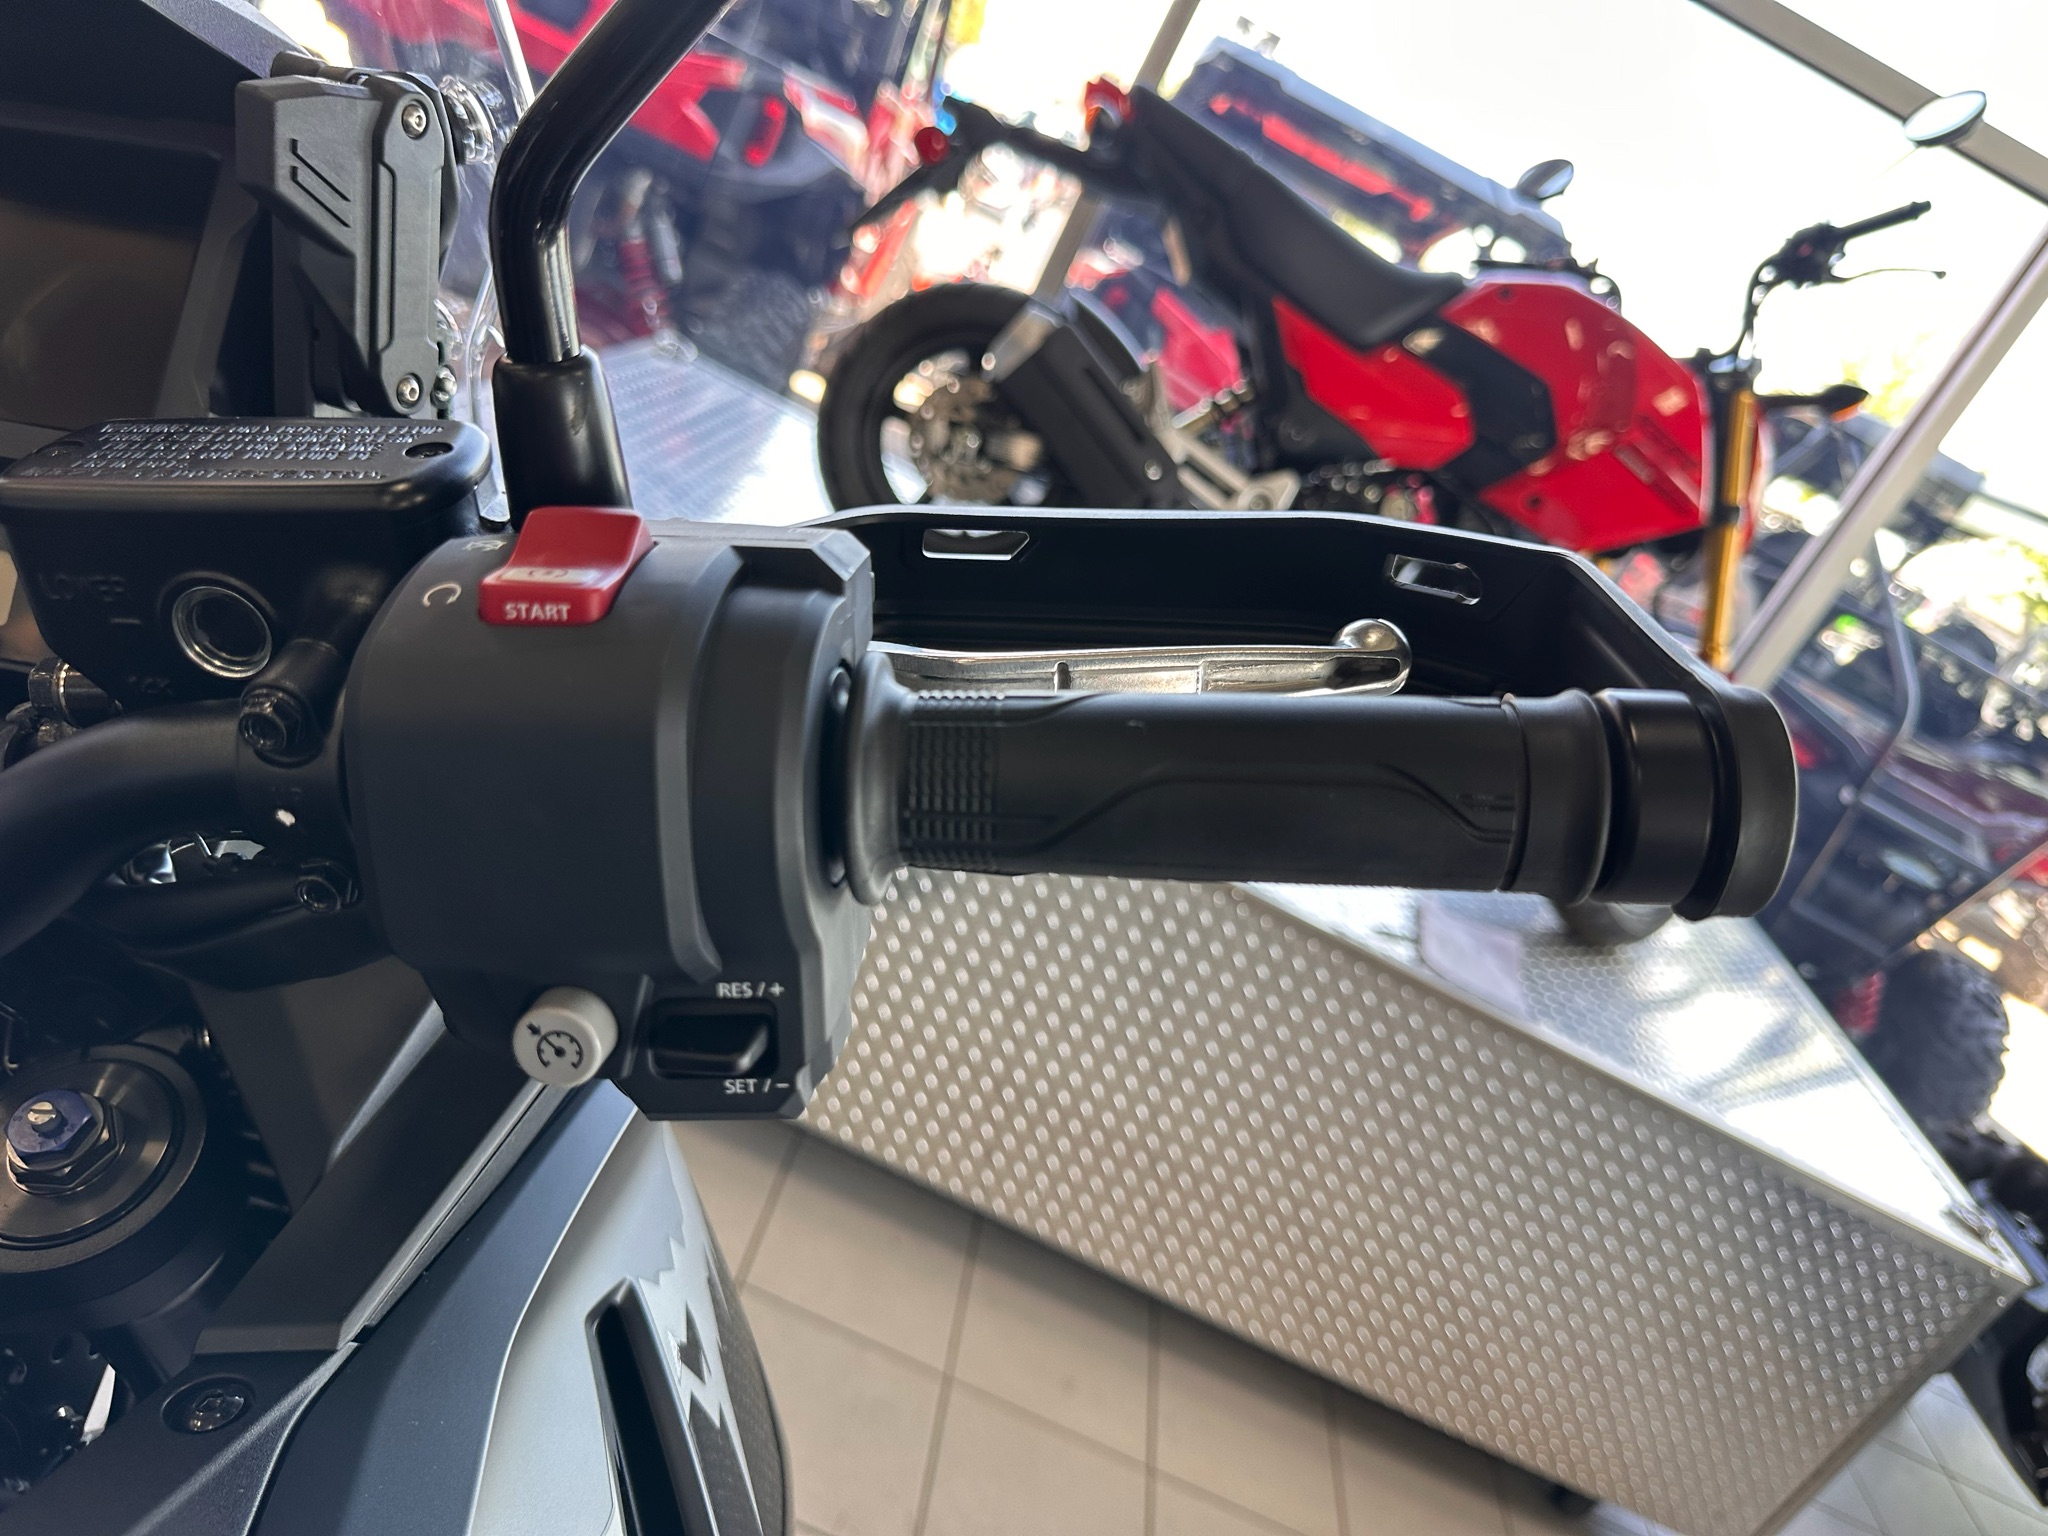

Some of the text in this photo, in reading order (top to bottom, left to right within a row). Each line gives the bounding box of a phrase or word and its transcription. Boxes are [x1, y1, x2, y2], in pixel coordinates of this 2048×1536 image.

[505, 602, 571, 621] START
[716, 981, 753, 998] RES
[723, 1078, 758, 1094] SET
